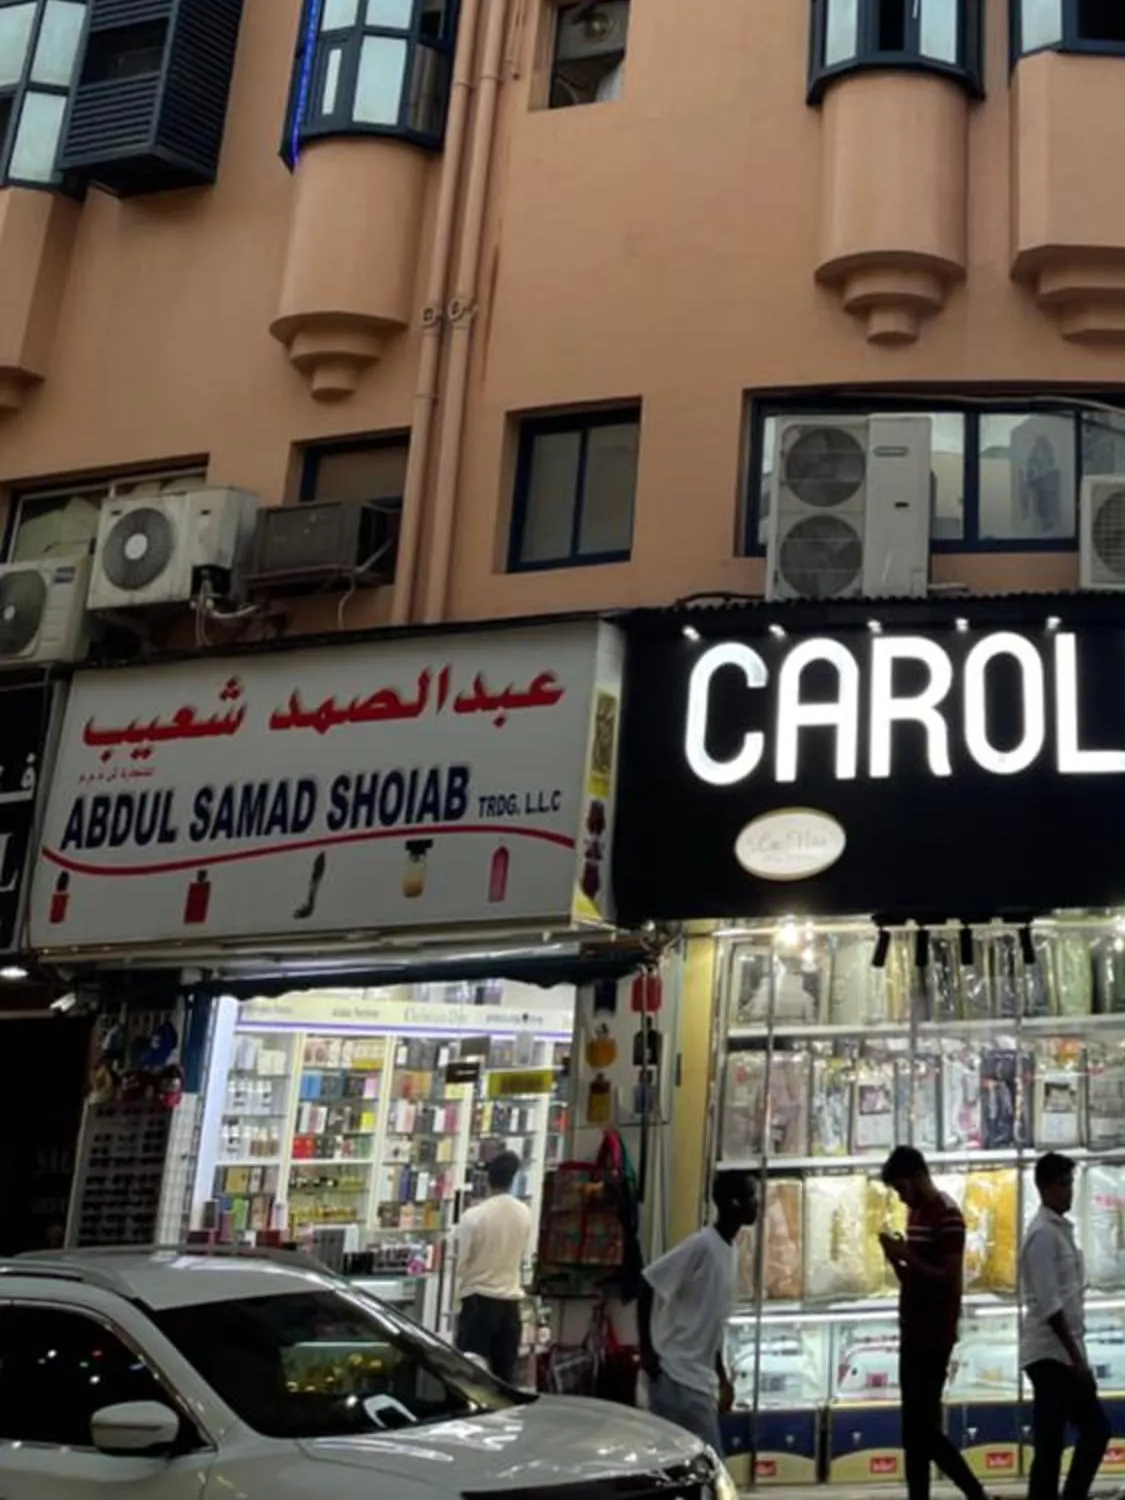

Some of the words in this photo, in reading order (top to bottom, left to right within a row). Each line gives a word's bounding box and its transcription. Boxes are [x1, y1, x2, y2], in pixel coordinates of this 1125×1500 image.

[83, 674, 248, 763] شعيب
[60, 787, 178, 852] ABDUL
[189, 776, 319, 843] SAMAD
[326, 764, 471, 832] SHOIAB
